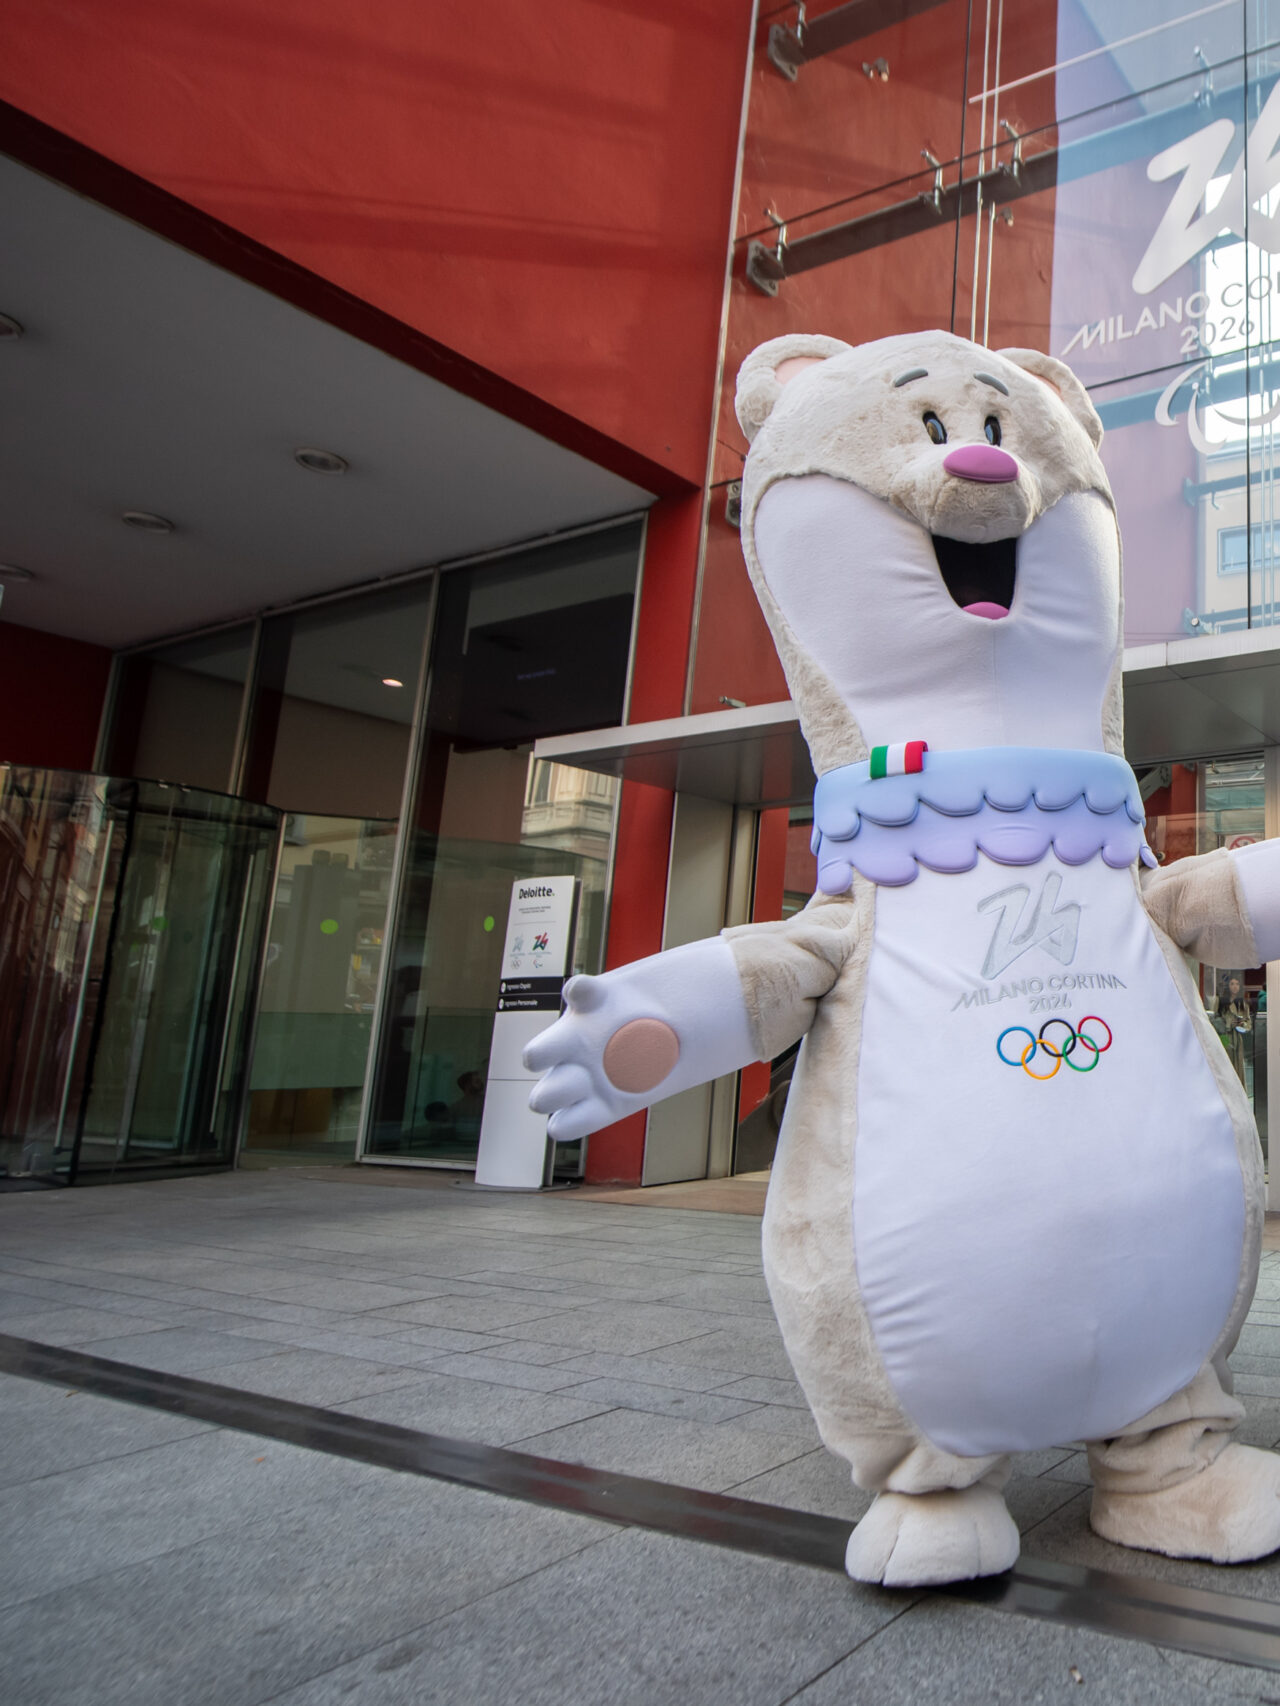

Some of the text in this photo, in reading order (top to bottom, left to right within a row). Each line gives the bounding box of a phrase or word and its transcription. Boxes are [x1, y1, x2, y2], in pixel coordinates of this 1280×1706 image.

[1061, 290, 1211, 357] MILANO
[1179, 312, 1256, 355] 2026
[950, 973, 1128, 1013] MILANO CORTINA
[1029, 992, 1073, 1015] 2026
